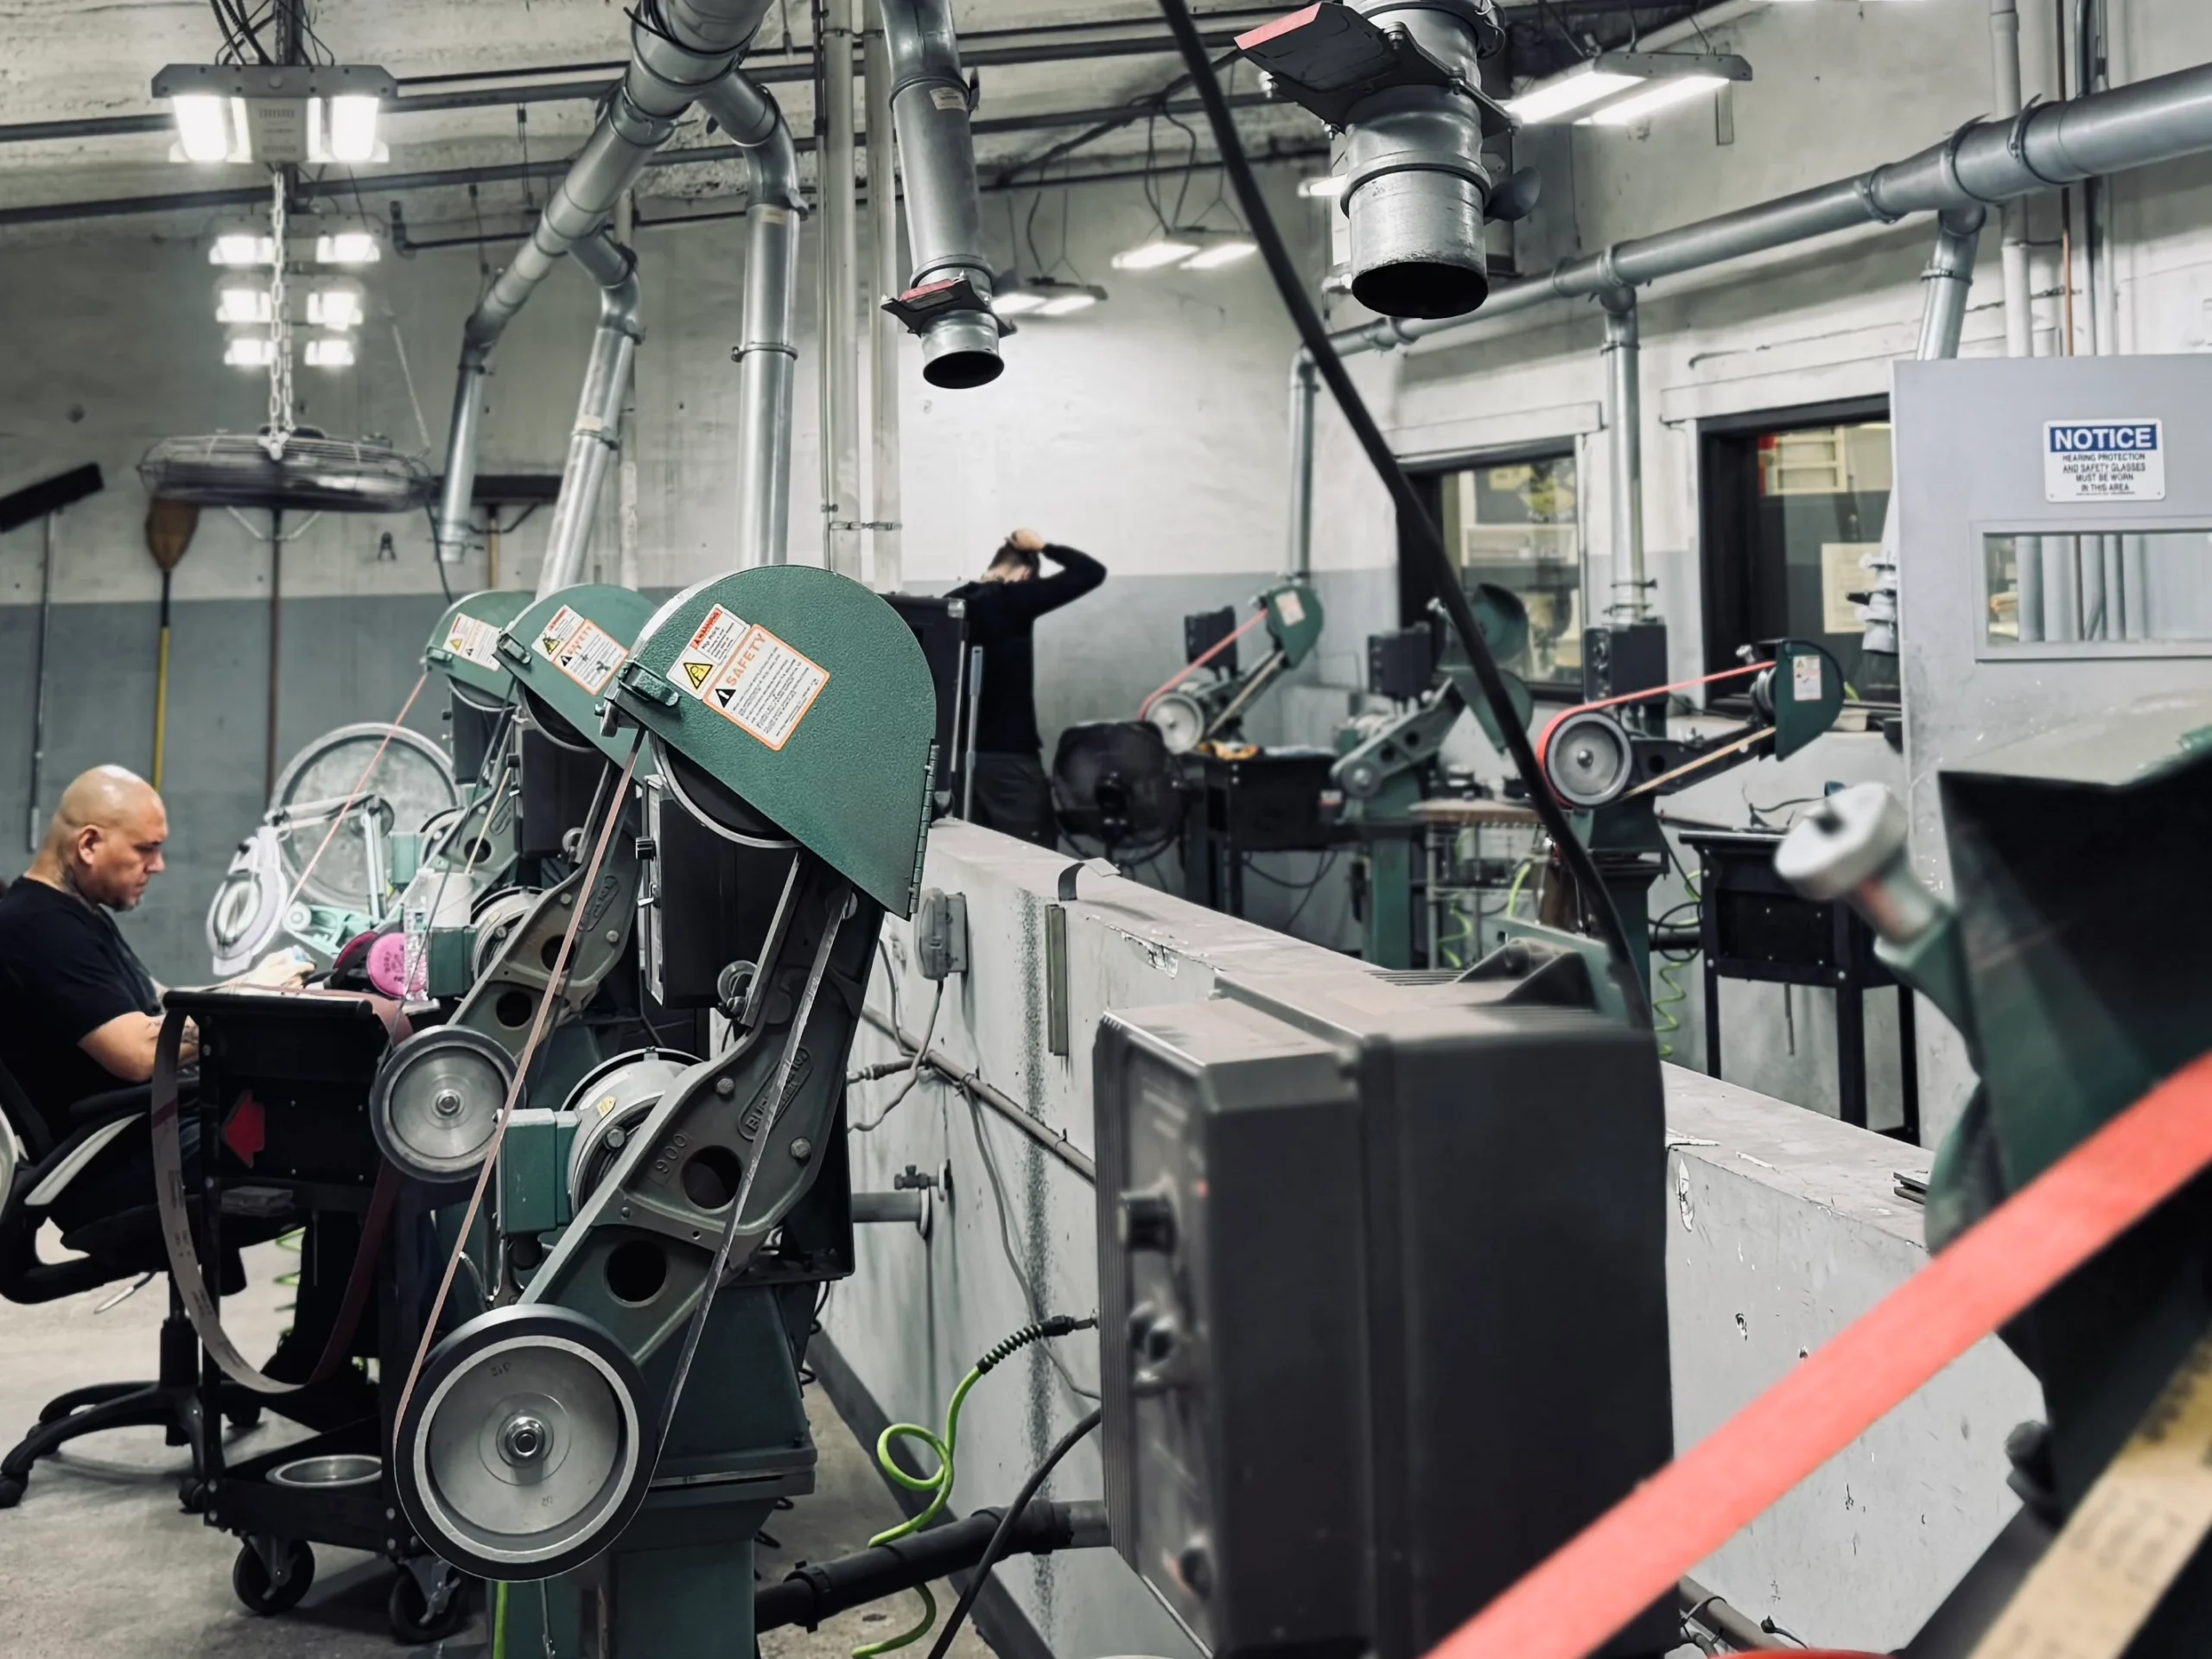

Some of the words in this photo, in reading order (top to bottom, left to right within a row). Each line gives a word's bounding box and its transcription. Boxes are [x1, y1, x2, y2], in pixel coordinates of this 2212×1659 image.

[2055, 428, 2152, 450] NOTICE
[2098, 453, 2145, 461] PROTECTION
[2063, 464, 2078, 473] AND
[2081, 463, 2108, 473] SAFETY
[2111, 462, 2145, 472] GLASSES
[2099, 473, 2108, 481] BE
[725, 632, 766, 687] SAFETY
[656, 1134, 687, 1173] 900
